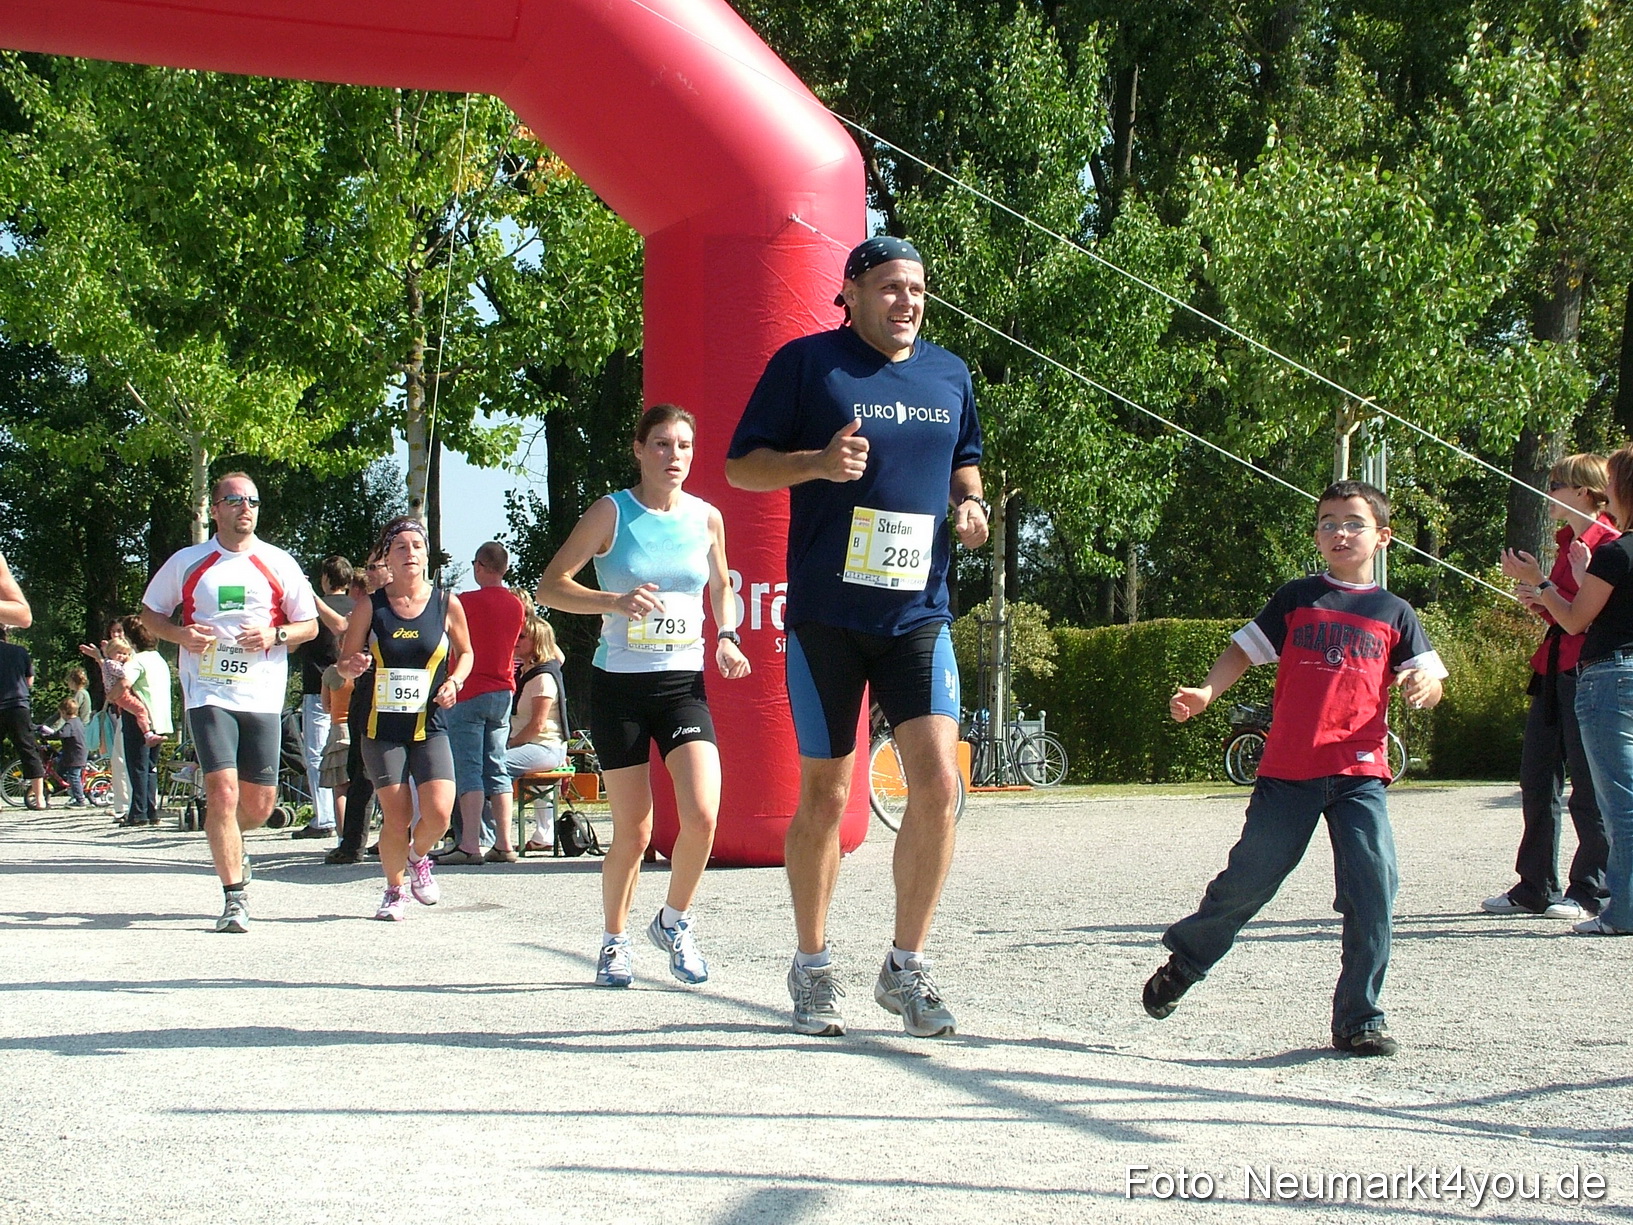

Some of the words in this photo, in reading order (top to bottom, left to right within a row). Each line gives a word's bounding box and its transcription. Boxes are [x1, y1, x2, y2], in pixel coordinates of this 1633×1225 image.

[853, 403, 895, 419] EURO
[908, 406, 951, 424] POLES
[877, 518, 913, 535] Stefan
[853, 537, 860, 548] B
[882, 546, 920, 568] 288
[653, 618, 686, 634] 793
[1293, 621, 1385, 659] BRADFORD
[217, 643, 244, 655] Jürgen
[203, 654, 208, 662] C
[220, 659, 248, 674] 955
[389, 672, 419, 682] Susanne
[394, 687, 420, 700] 954
